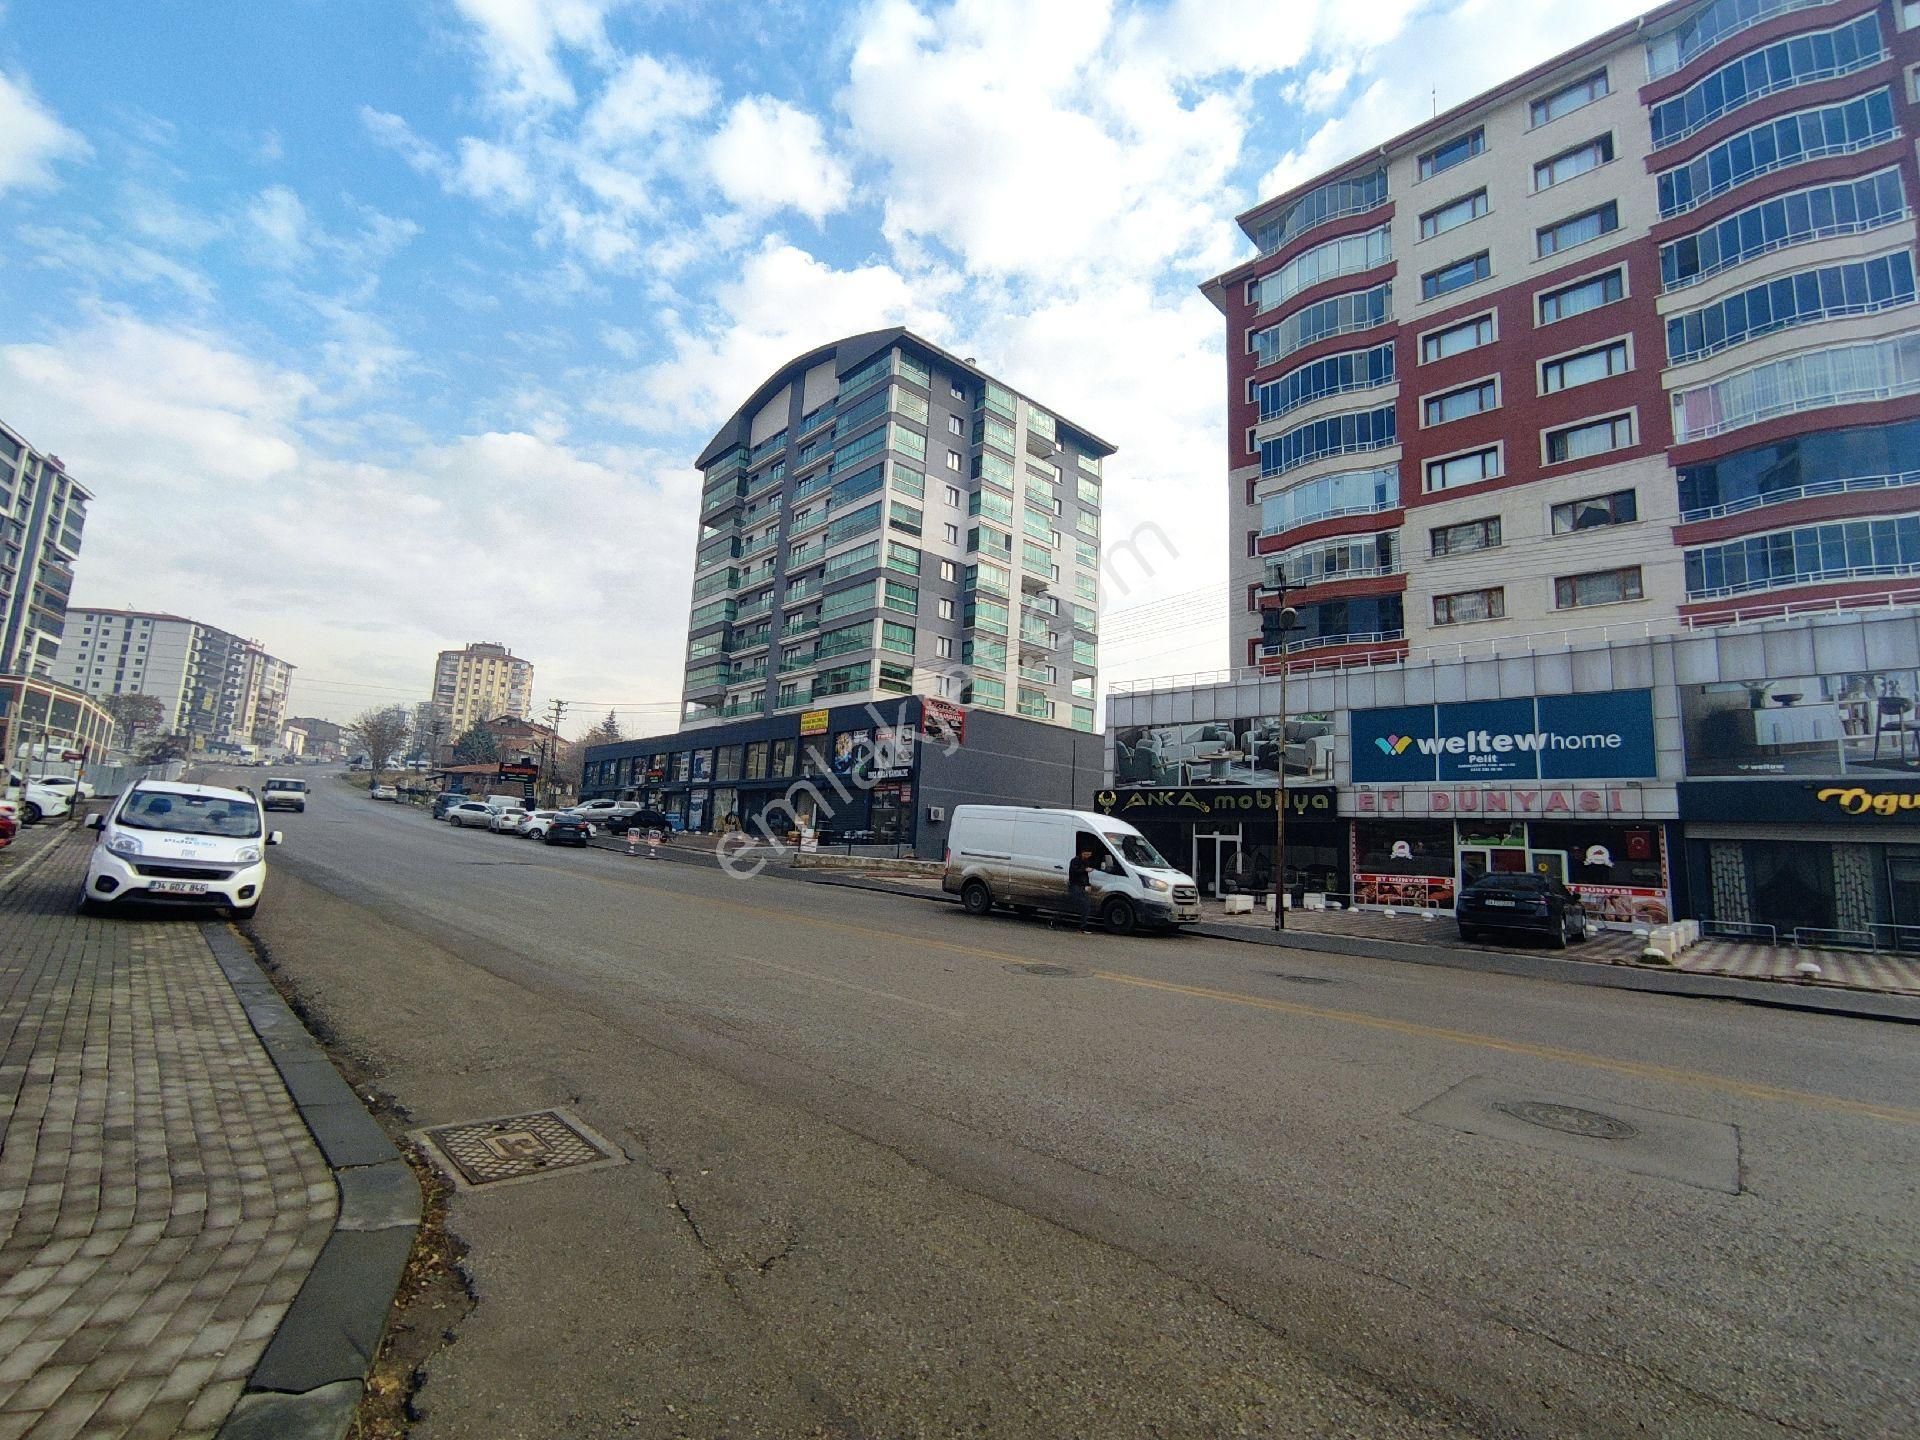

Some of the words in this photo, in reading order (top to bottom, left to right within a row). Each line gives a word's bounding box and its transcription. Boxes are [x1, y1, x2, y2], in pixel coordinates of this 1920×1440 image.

[1468, 754, 1498, 764] Pelit
[1122, 791, 1211, 813] ANKA
[1214, 790, 1329, 815] moblya
[1358, 791, 1400, 812] ET
[1431, 785, 1624, 812] DÜNYASI
